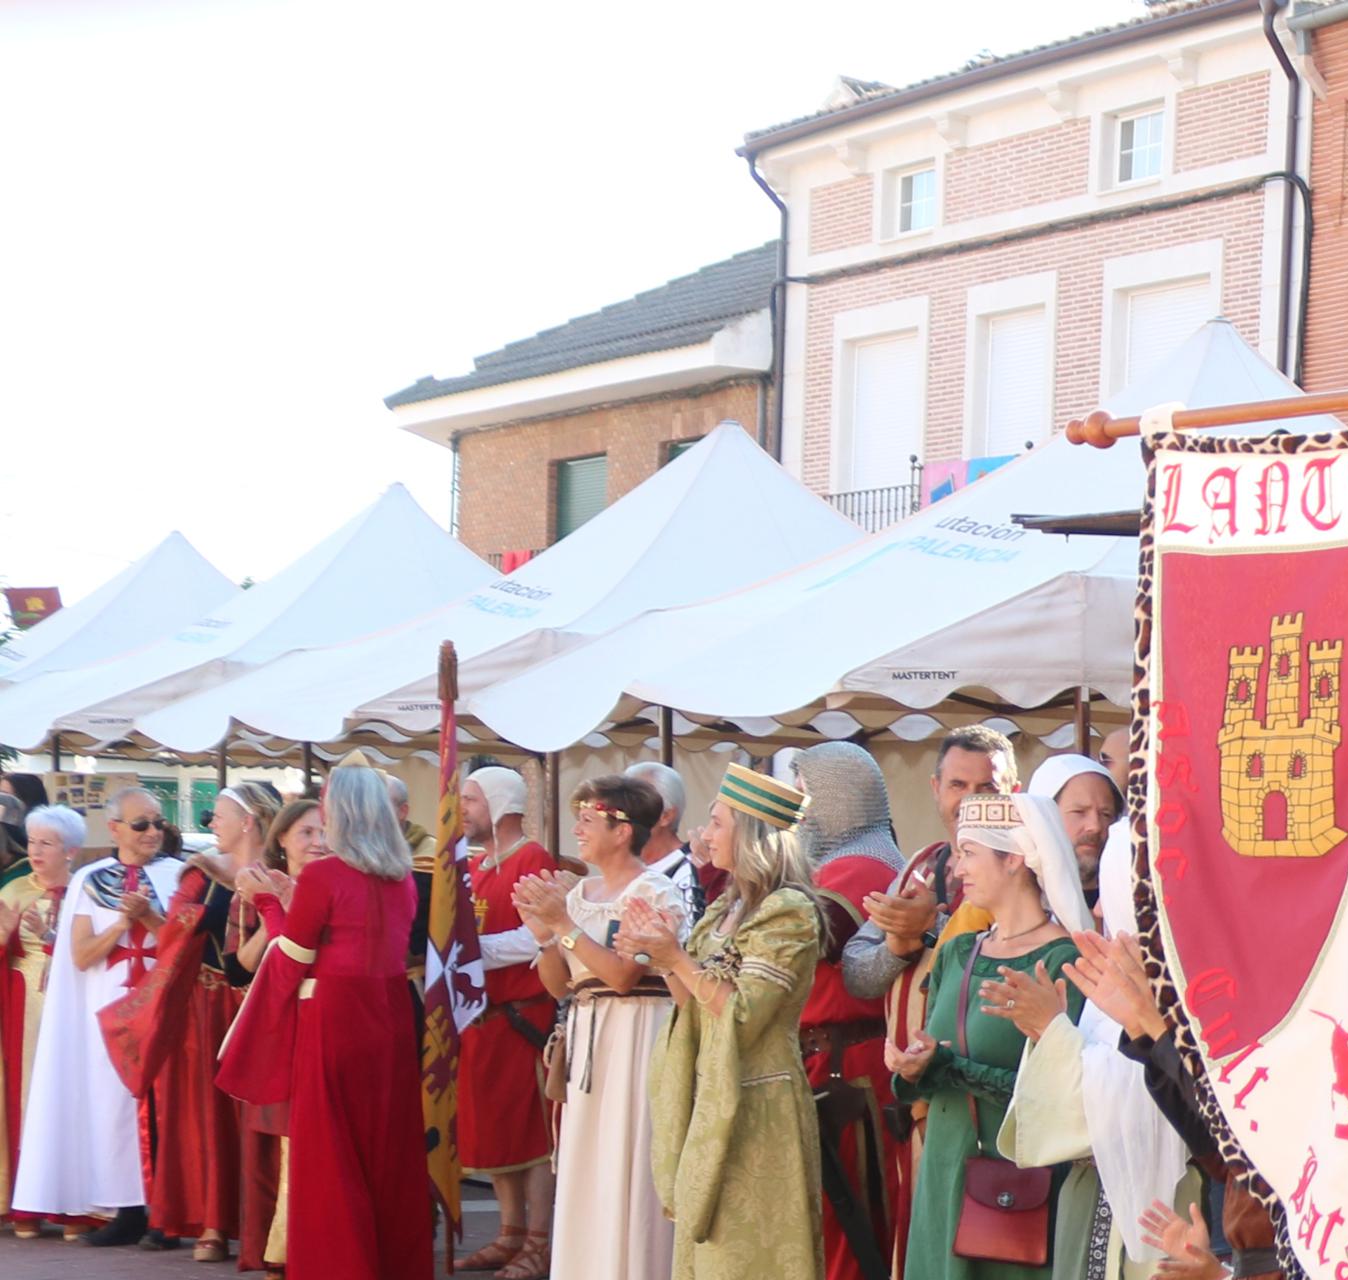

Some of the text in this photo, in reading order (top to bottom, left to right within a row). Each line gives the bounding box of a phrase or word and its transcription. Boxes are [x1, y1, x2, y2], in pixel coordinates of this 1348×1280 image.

[934, 514, 1027, 542] utación
[489, 579, 552, 602] utación
[892, 670, 959, 681] MASTERTENT
